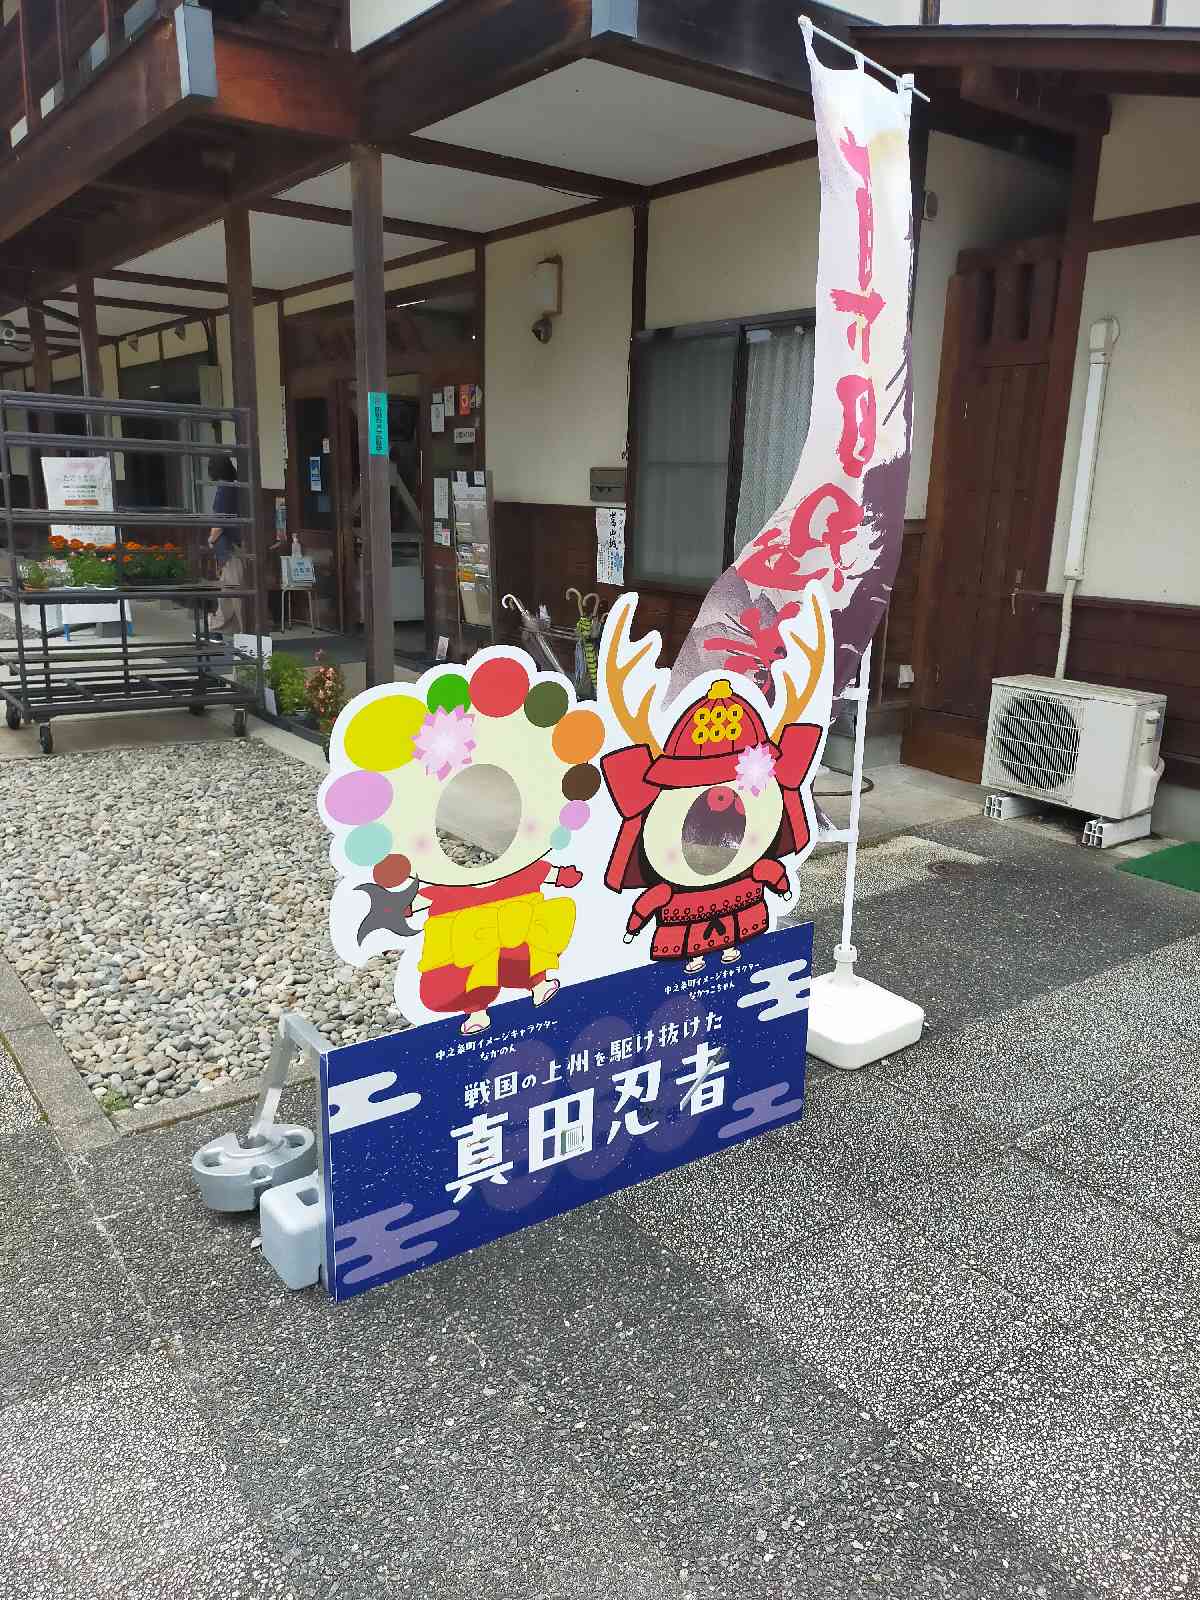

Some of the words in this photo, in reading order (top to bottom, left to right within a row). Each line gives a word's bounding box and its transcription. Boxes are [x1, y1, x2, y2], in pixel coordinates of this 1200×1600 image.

[664, 963, 760, 994] 中之条町イメージキャラクター
[434, 1019, 558, 1061] 中之条町イメージキャラクター
[464, 1011, 724, 1109] 戦国の上州を駆け抜けた
[480, 1044, 517, 1061] なかのん
[445, 1041, 730, 1203] 真田忍者
